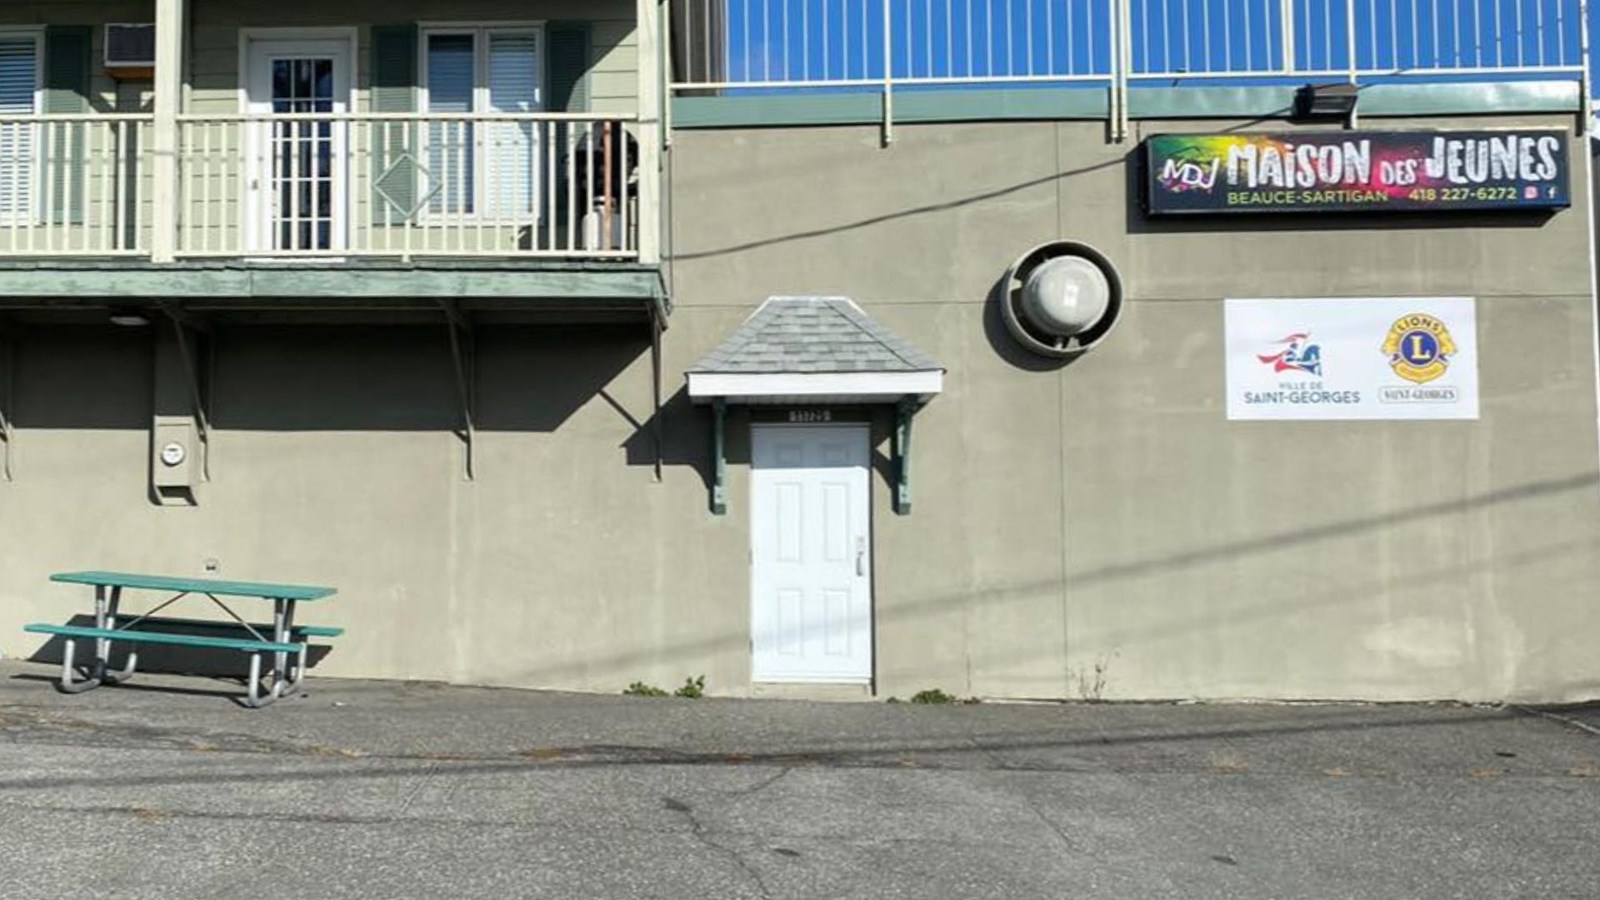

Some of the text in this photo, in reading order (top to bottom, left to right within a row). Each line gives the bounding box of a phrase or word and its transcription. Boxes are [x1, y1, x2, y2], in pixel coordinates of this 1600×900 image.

[1380, 159, 1417, 185] DES
[1425, 135, 1559, 184] JEUNES
[1163, 157, 1220, 188] MDJ
[1227, 188, 1388, 205] BEAUCE-SARTIGAN
[1408, 188, 1437, 201] 418
[1441, 187, 1518, 201] 227-6272
[1396, 316, 1441, 331] LIONS
[1411, 335, 1431, 359] L
[1244, 390, 1361, 404] SAINT-GEORGES
